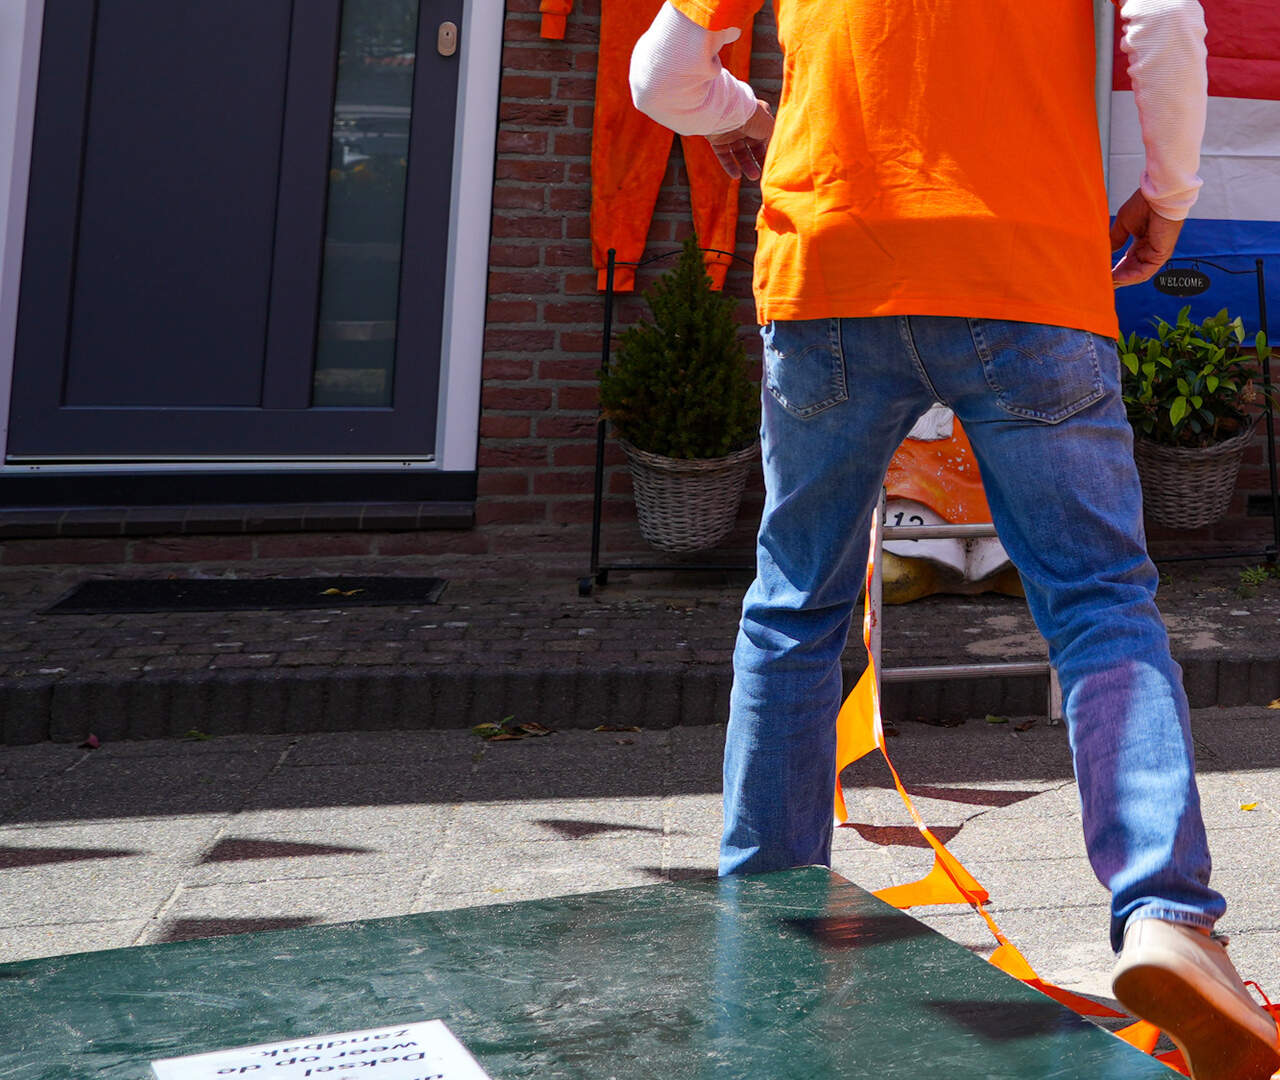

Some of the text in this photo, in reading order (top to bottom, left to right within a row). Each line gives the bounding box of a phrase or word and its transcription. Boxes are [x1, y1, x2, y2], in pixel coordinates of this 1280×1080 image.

[1159, 276, 1205, 289] WELCOME
[217, 1041, 418, 1075] weer op de
